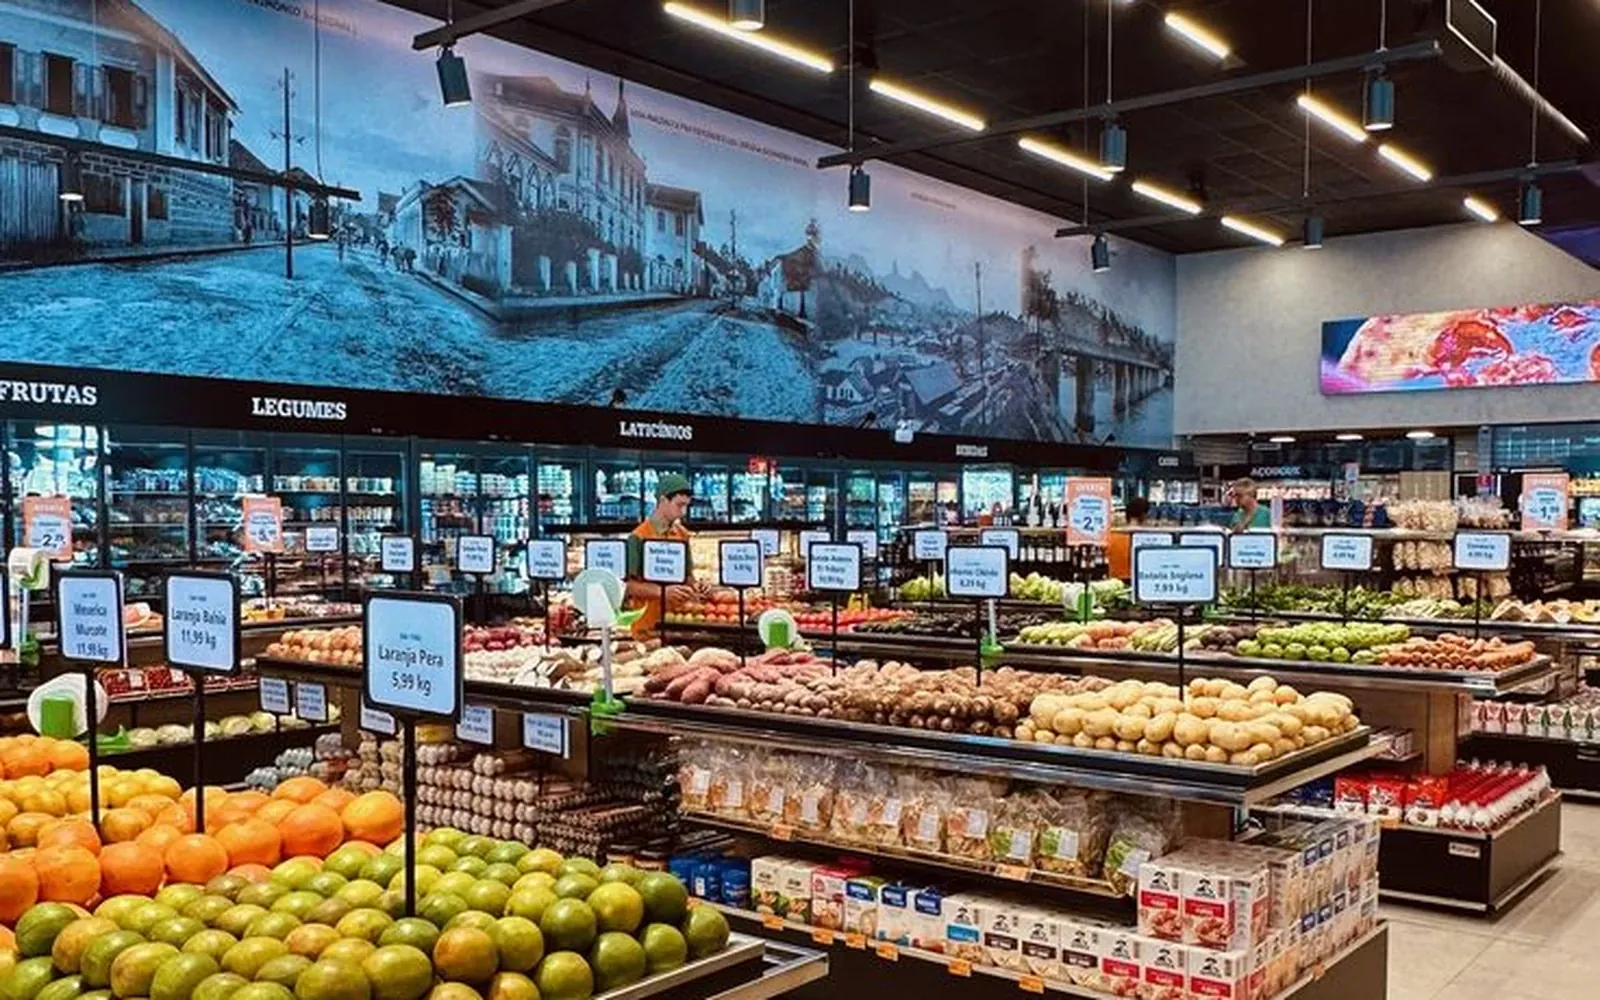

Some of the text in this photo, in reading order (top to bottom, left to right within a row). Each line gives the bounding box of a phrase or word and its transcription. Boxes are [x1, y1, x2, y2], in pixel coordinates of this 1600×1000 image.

[0, 380, 98, 406] FRUTAS
[251, 396, 348, 420] LEGUMES
[619, 419, 693, 442] LATICÍNIOS
[1175, 583, 1189, 594] kg
[98, 644, 109, 660] kg
[205, 630, 217, 651] kg
[378, 643, 444, 669] Laranja Pera
[391, 671, 432, 697] 5,99 kg
